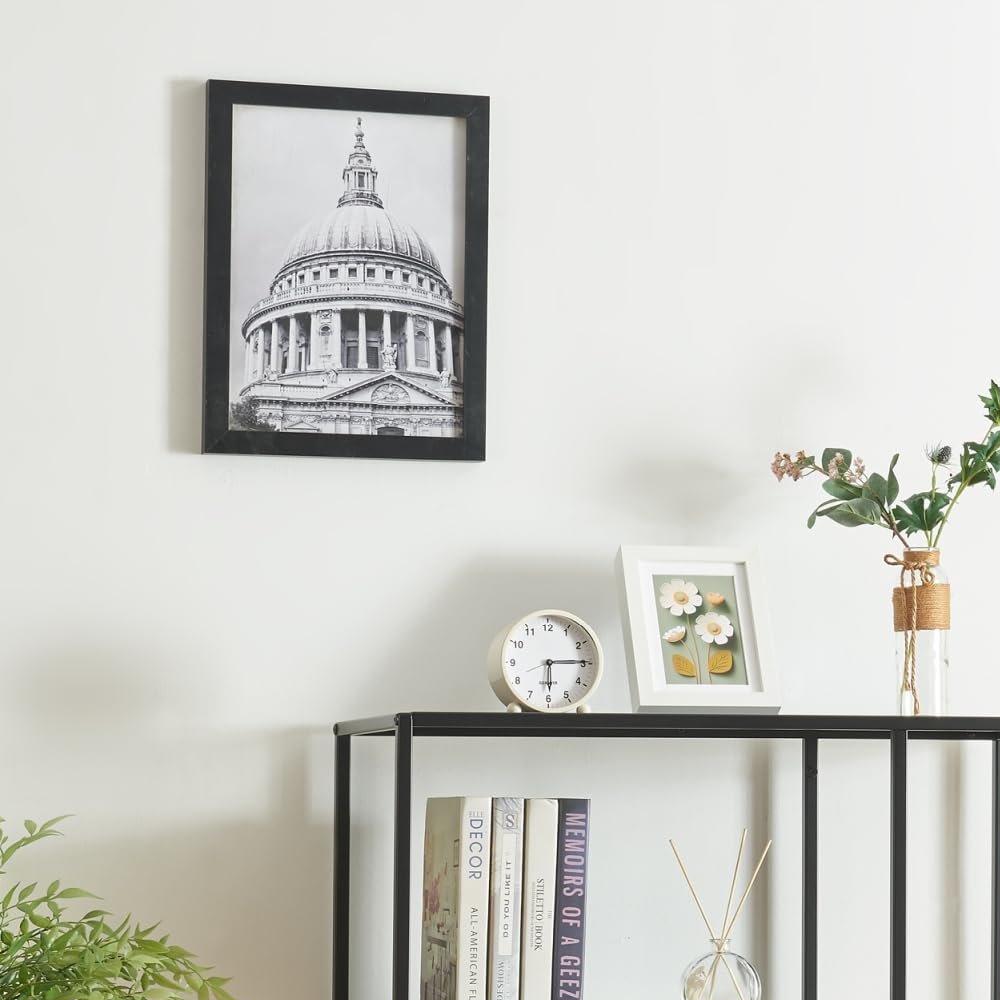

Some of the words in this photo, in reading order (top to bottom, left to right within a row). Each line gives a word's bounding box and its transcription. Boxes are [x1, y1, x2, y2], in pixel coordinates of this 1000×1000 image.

[525, 628, 535, 636] 11
[542, 624, 554, 632] 12
[563, 629, 568, 637] 1
[513, 641, 524, 649] 10
[575, 641, 582, 650] 2
[510, 658, 516, 667] 9
[580, 659, 587, 668] 3
[514, 676, 521, 685] 8
[575, 677, 582, 685] 4
[527, 690, 533, 699] 7
[545, 694, 552, 703] 6
[563, 690, 569, 699] 5
[505, 813, 515, 829] S
[469, 819, 483, 880] DECOR
[563, 813, 586, 897] MEMOIRS
[505, 860, 512, 870] IT
[535, 878, 545, 921] STILETTO
[561, 906, 582, 928] OF
[502, 923, 509, 938] DO
[534, 925, 544, 951] BOOK
[560, 936, 580, 945] A
[469, 907, 479, 985] ALL-AMERICAN
